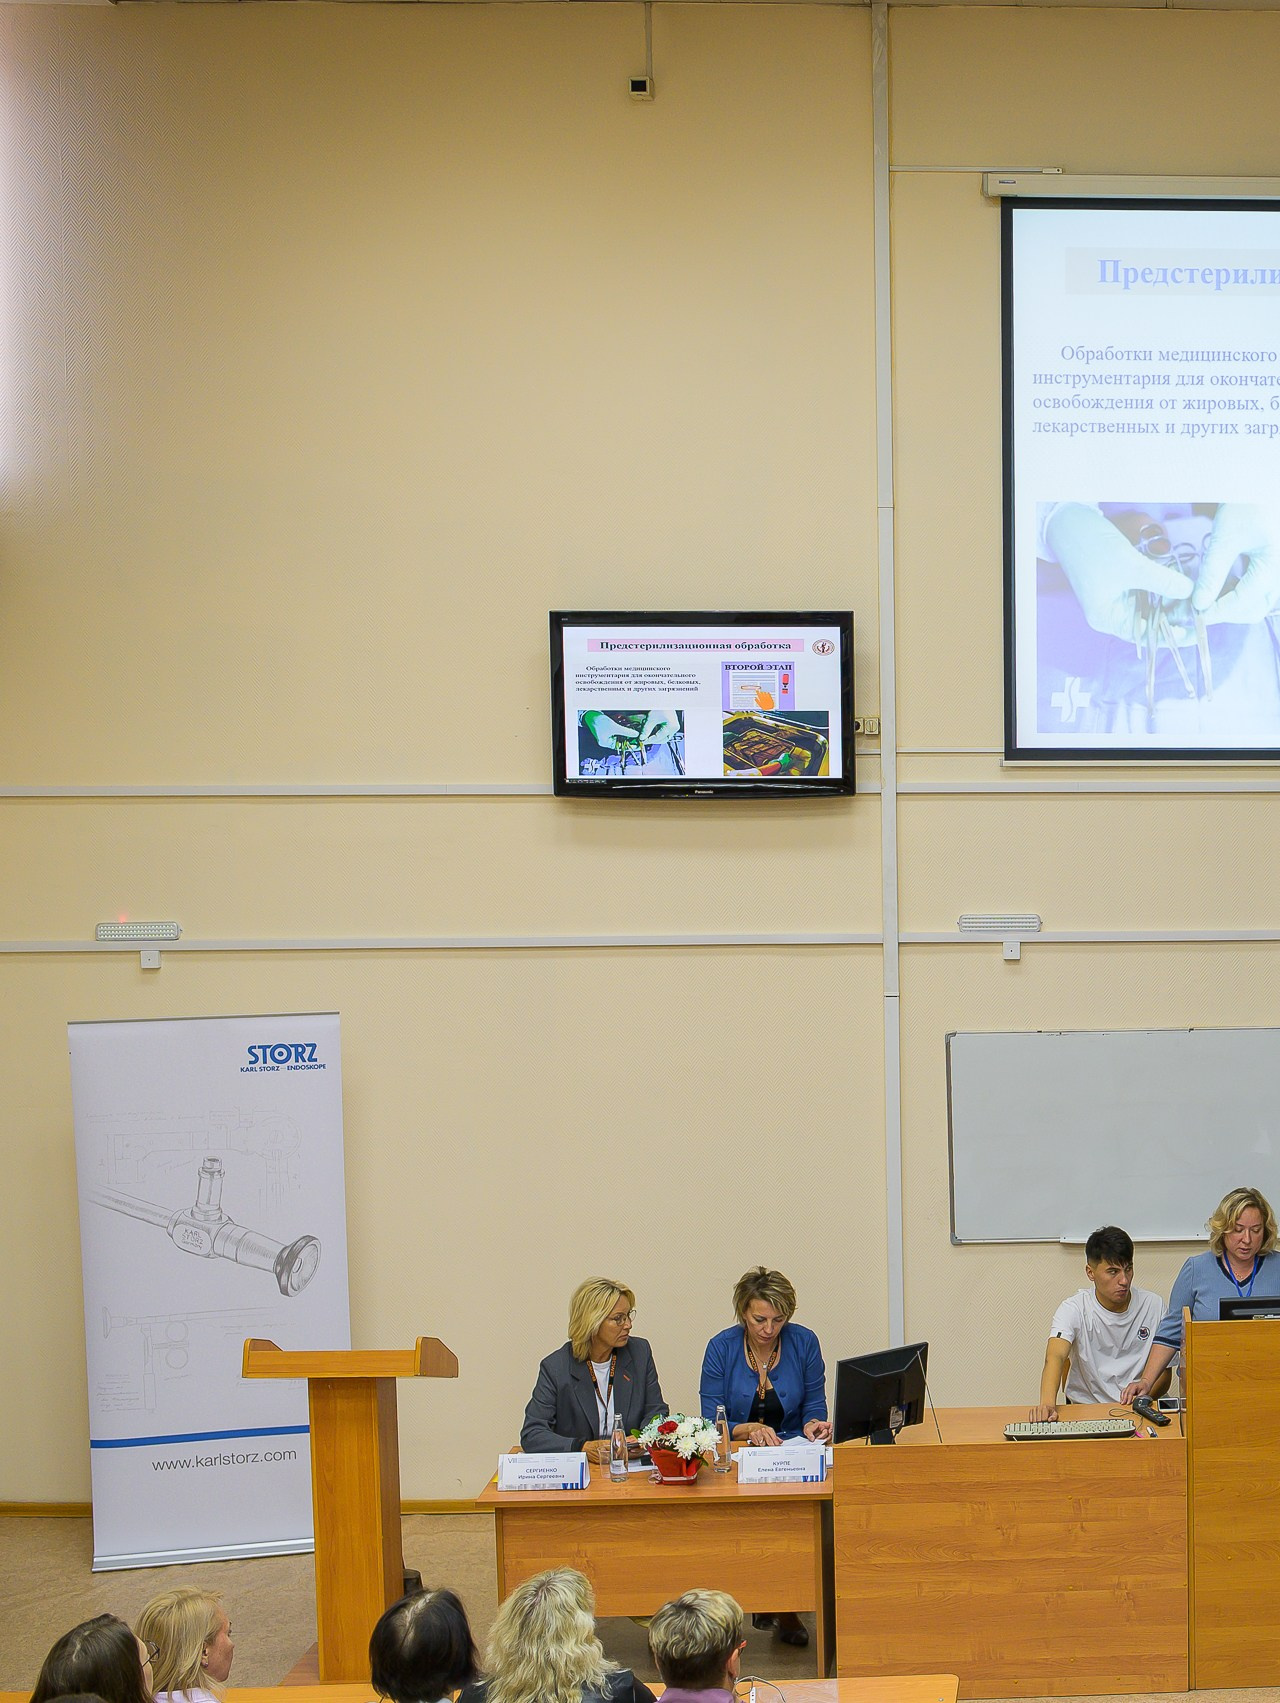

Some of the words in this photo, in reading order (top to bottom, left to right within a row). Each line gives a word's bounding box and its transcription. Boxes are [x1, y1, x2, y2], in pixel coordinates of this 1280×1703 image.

[1061, 345, 1152, 364] Обработки
[1158, 349, 1277, 364] медицинского
[1032, 371, 1170, 389] инструментария
[1175, 374, 1204, 388] для
[1032, 394, 1154, 412] освобождения
[1159, 398, 1178, 410] от
[1182, 398, 1265, 414] жировых,
[1032, 421, 1160, 436] лекарственных
[1165, 423, 1176, 435] и
[1181, 423, 1239, 437] других
[600, 641, 732, 651] Предстерилизационная
[734, 642, 791, 651] обработка
[725, 663, 764, 671] ВТОРОЙ
[248, 1043, 318, 1065] STORZ
[152, 1449, 297, 1471] www.karlstorz.com
